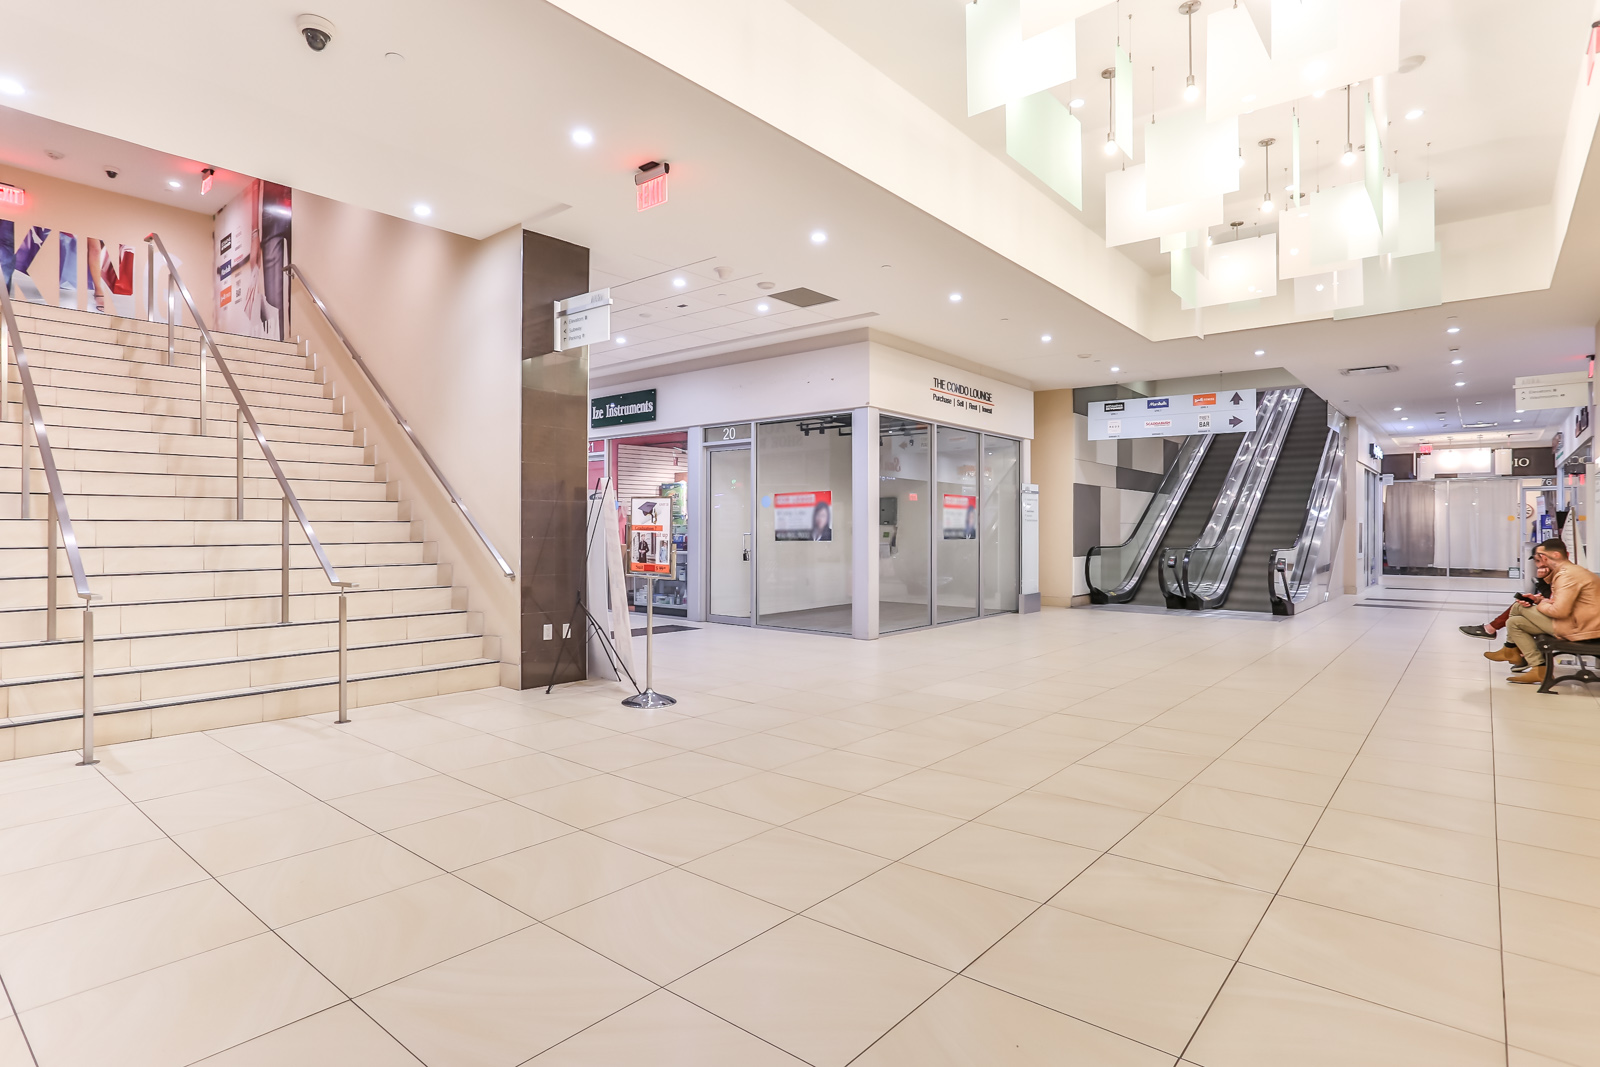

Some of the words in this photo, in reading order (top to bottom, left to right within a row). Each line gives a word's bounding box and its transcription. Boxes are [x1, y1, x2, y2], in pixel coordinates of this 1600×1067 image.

[643, 175, 664, 208] EXIT
[933, 377, 946, 390] THE
[947, 381, 969, 396] CONDO
[970, 387, 993, 403] LOUNGE
[605, 400, 654, 418] Instruments
[932, 393, 952, 405] Purchase
[969, 402, 977, 411] Rent
[982, 406, 993, 414] Invest
[722, 427, 736, 440] 20
[1541, 478, 1553, 486] 76
